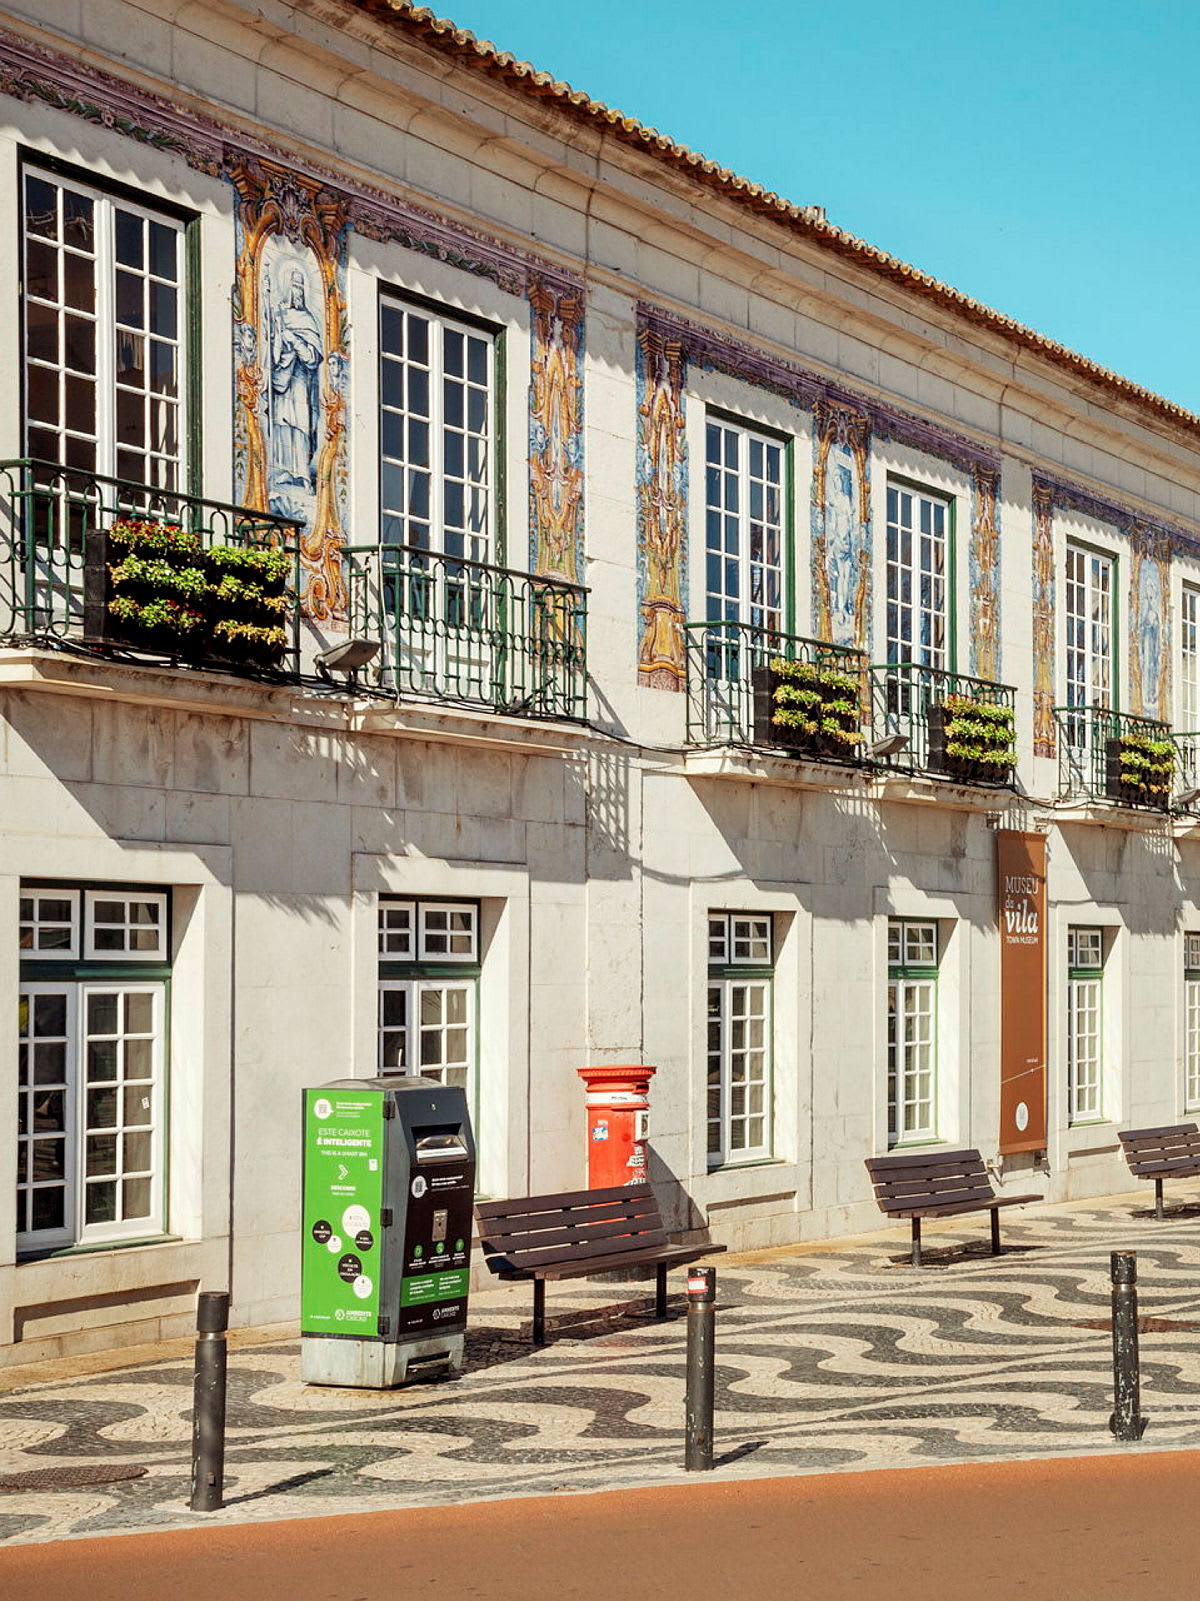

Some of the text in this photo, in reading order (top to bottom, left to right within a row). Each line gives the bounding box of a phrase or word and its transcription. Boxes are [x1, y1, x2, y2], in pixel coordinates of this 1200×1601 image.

[1005, 876, 1039, 894] MUSEU
[1005, 899, 1039, 933] vila
[1020, 936, 1039, 944] MUSEUM
[318, 1128, 371, 1137] ESTE CAIXOTE
[323, 1138, 372, 1147] INTELIGENTE
